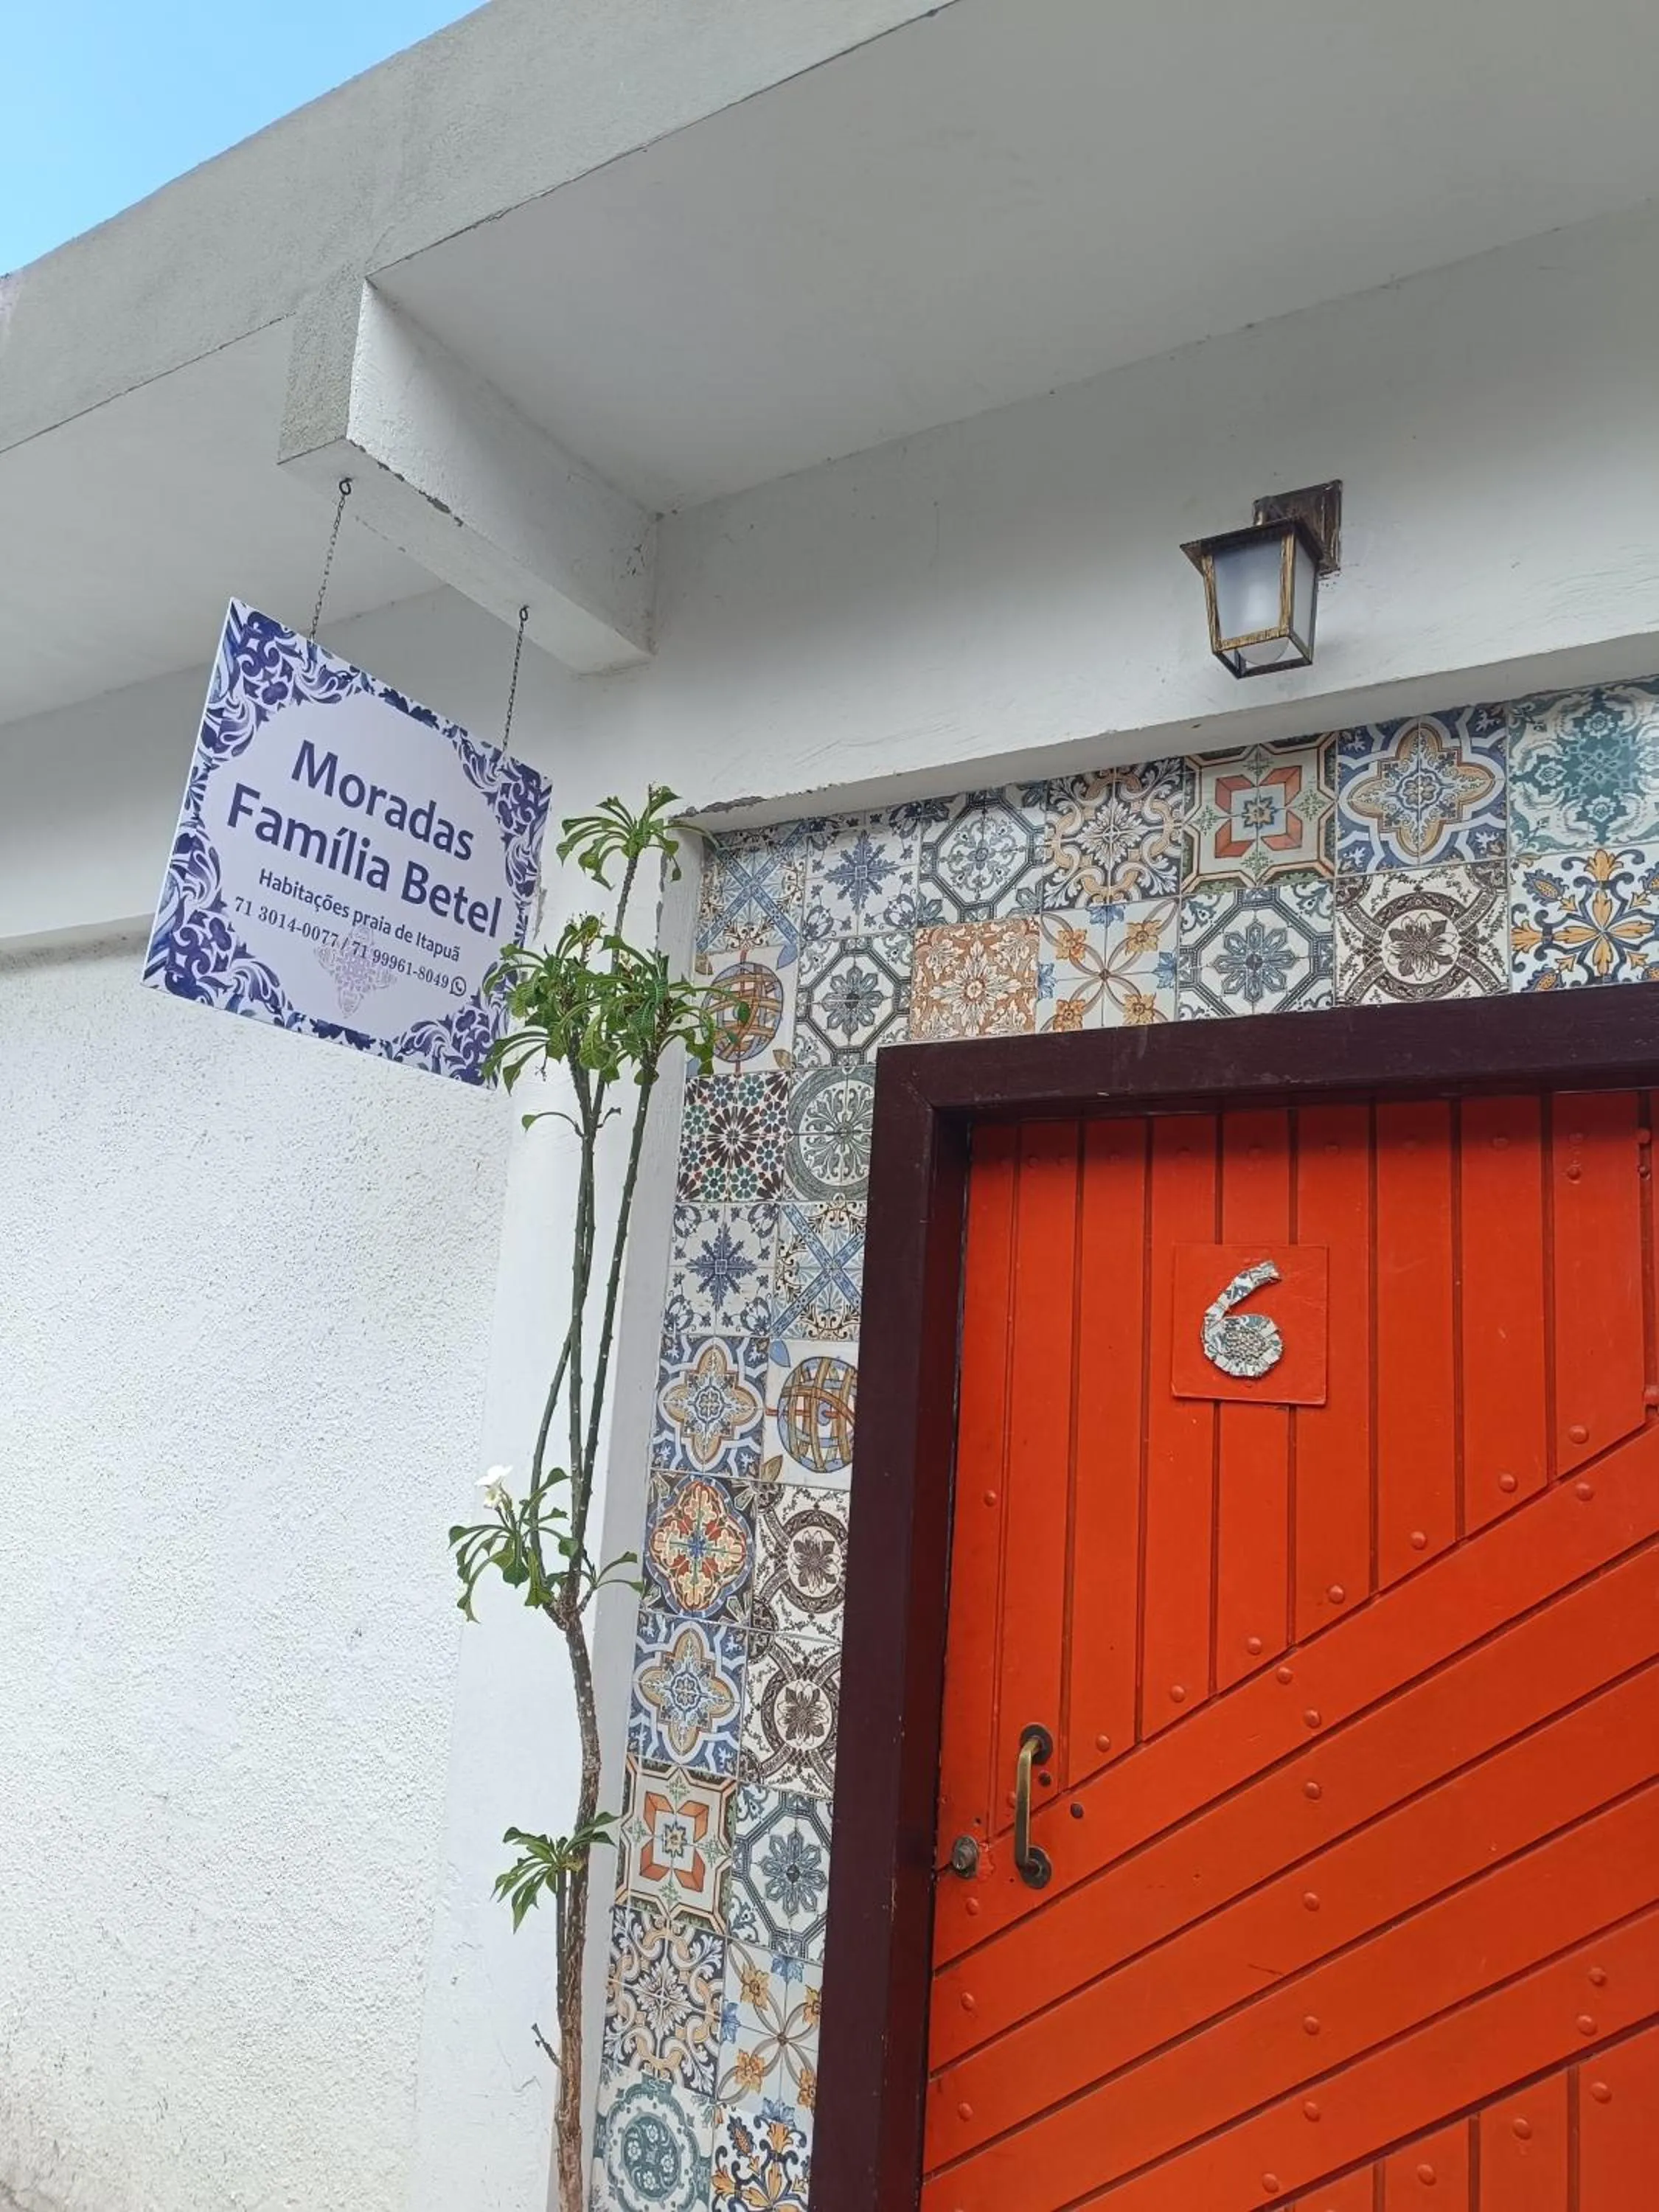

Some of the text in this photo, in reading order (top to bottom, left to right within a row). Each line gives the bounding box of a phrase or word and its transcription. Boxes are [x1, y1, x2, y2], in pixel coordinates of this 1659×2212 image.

[292, 740, 473, 861] Moradas
[227, 783, 501, 938] Família Betel
[259, 868, 461, 961] Habitações praia de Itapuã
[234, 896, 449, 989] 71 3014-0077 / 71 99961-8049
[1200, 1259, 1284, 1378] 6
